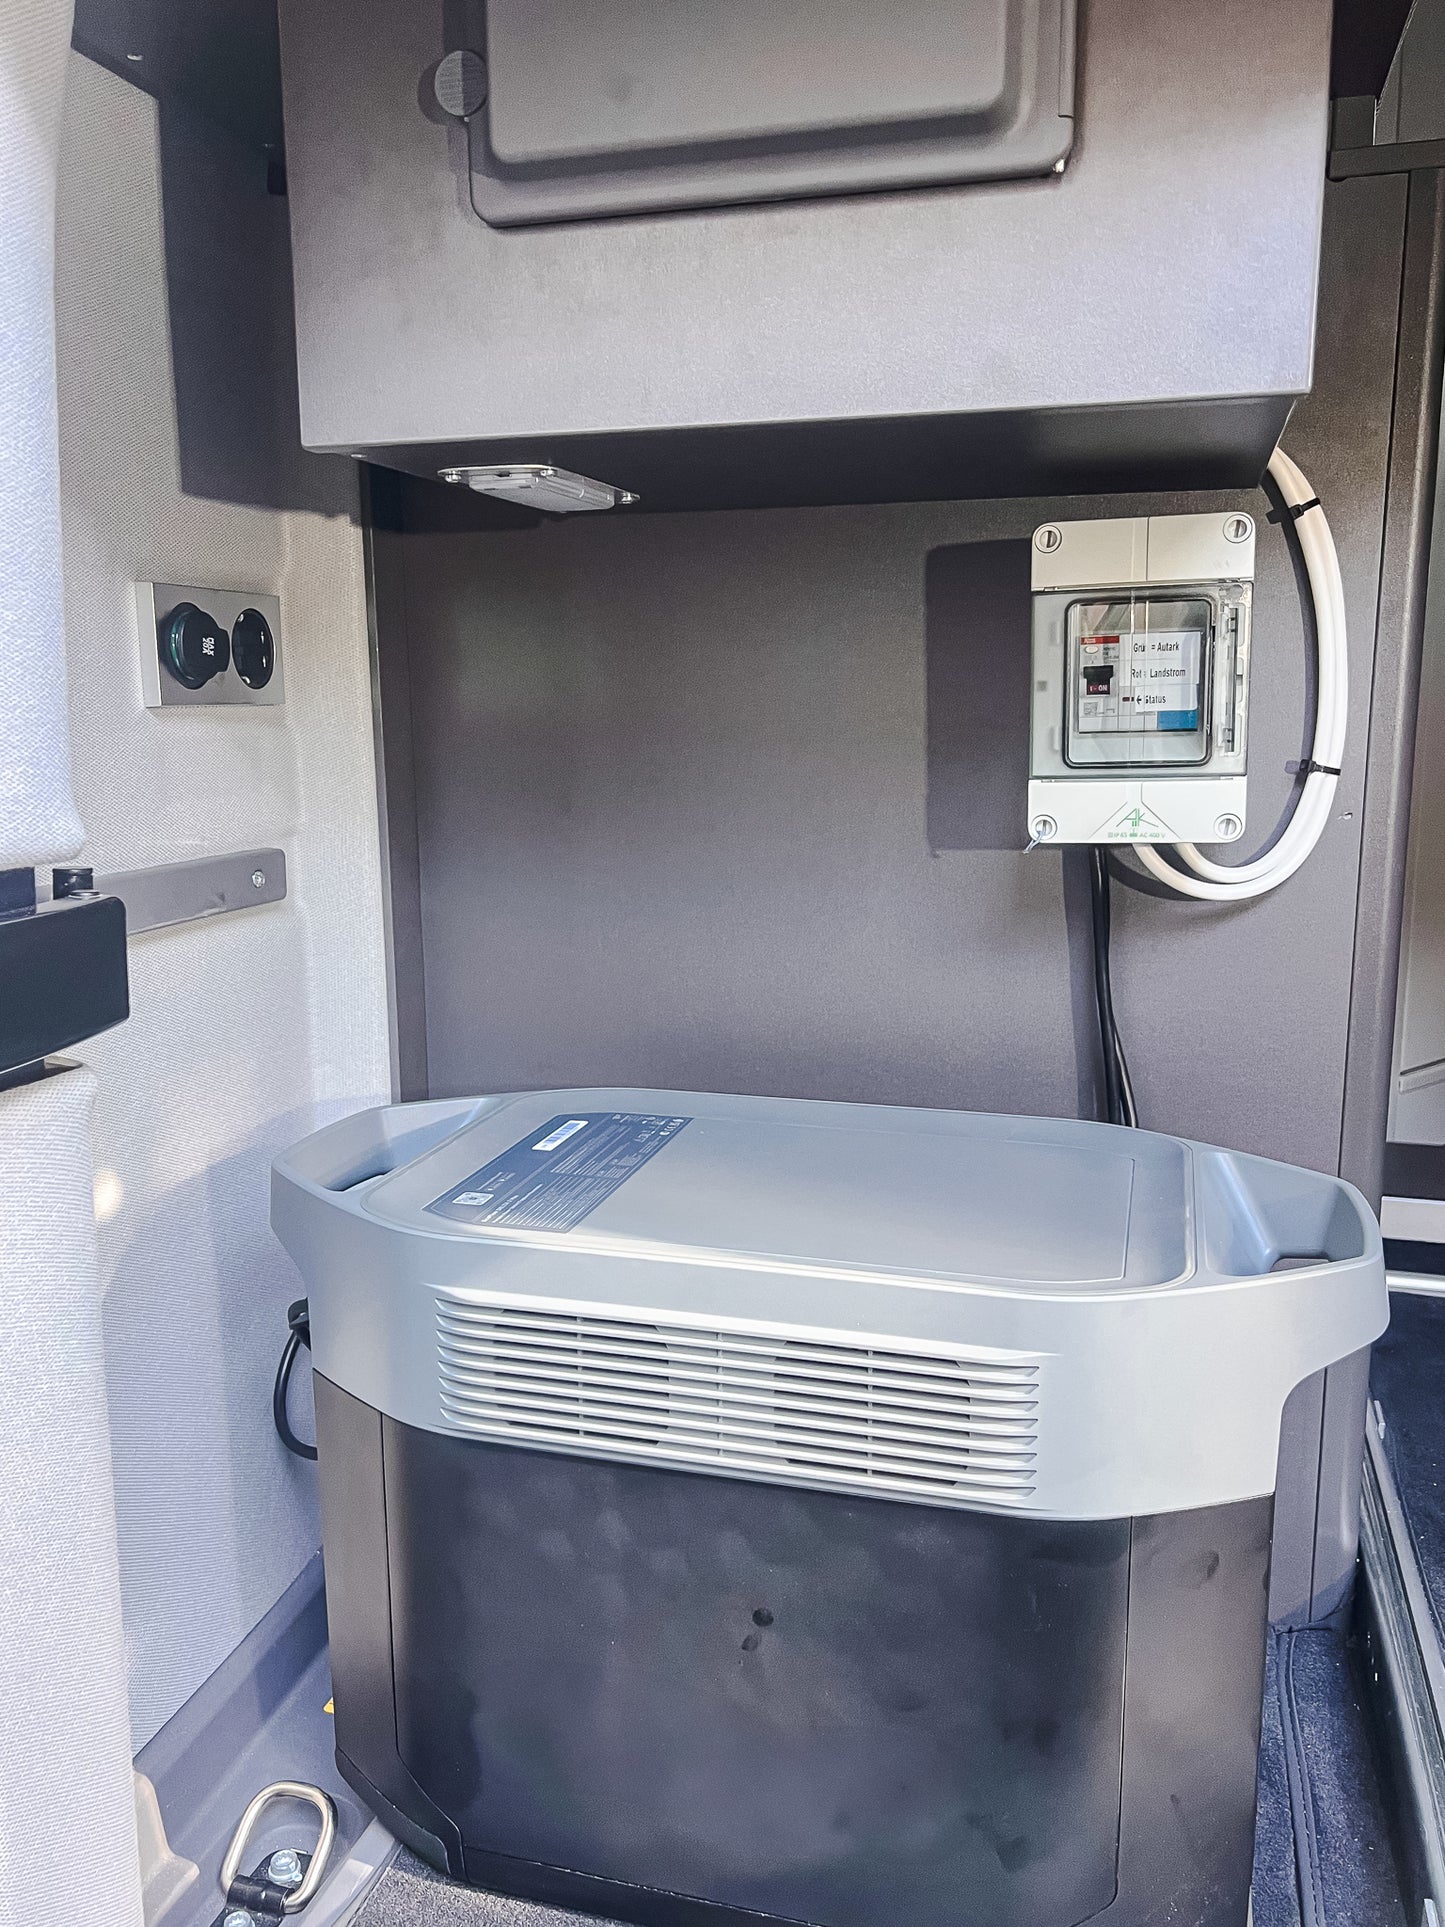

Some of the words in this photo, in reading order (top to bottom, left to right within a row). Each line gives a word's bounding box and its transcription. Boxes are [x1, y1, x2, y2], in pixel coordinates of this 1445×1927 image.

[1157, 641, 1179, 652] Autark
[1131, 668, 1142, 678] Rot
[1149, 667, 1186, 678] Landstrom
[1098, 684, 1108, 692] ON
[1145, 694, 1166, 704] Status
